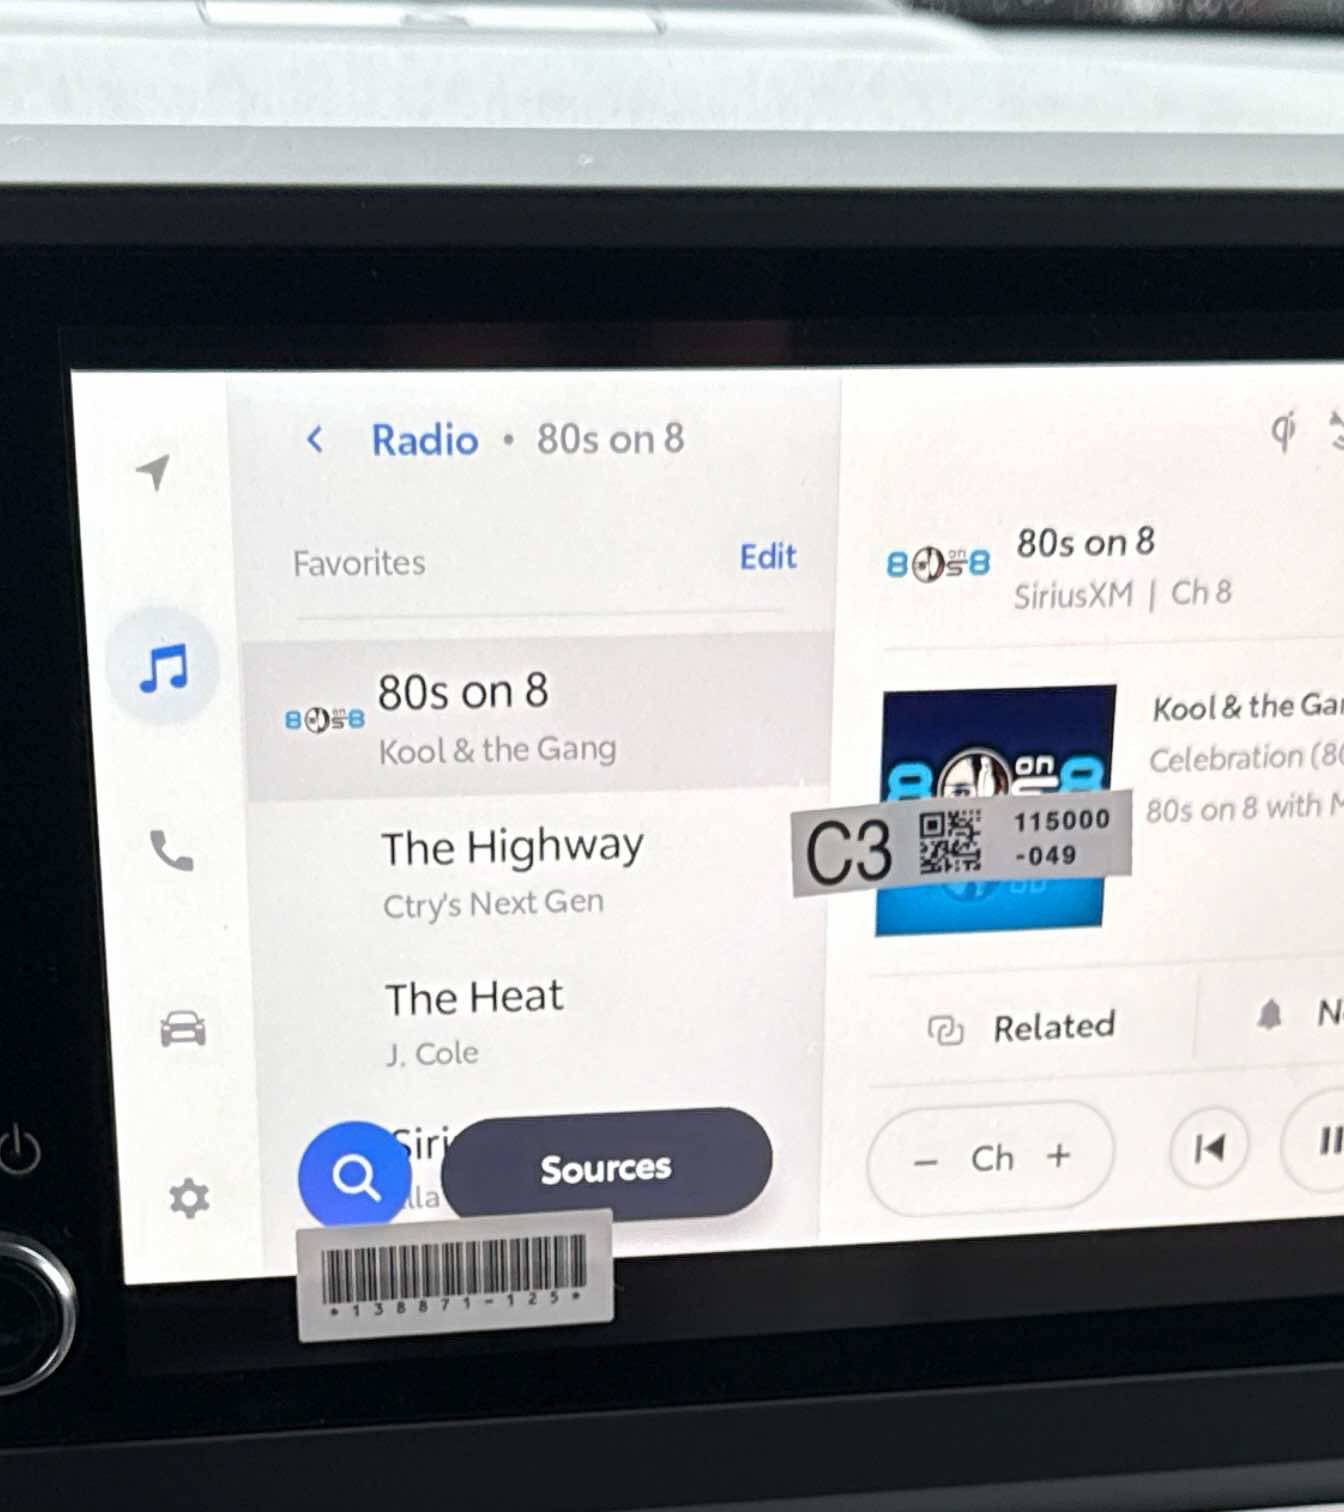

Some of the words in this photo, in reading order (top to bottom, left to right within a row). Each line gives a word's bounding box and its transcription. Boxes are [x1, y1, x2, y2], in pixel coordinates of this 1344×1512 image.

[373, 422, 479, 458] Radio
[537, 424, 599, 456] 80s
[609, 430, 654, 454] on
[665, 423, 685, 454] 8
[740, 543, 798, 572] Edit
[1017, 527, 1075, 559] 80s
[1084, 533, 1128, 557] on
[1136, 526, 1155, 556] 8
[293, 550, 426, 578] Favorites
[1014, 582, 1133, 611] SiriusXM
[1171, 579, 1209, 608] Ch
[1214, 579, 1232, 605] 8
[378, 674, 449, 711] 80s
[462, 681, 513, 708] on
[526, 672, 549, 707] 8
[1153, 695, 1215, 722] Kool
[1221, 695, 1242, 720] &
[1248, 693, 1295, 719] the
[379, 738, 447, 766] Kool
[453, 738, 476, 764] &
[482, 737, 531, 763] the
[537, 736, 617, 768] Gang
[1016, 755, 1055, 775] on
[1150, 745, 1304, 774] Celebration
[1015, 808, 1112, 832] 115000
[1147, 798, 1194, 825] 80s
[1201, 801, 1235, 822] on
[1242, 796, 1259, 822] 8
[1266, 790, 1323, 820] with
[382, 831, 455, 867] The
[468, 827, 646, 872] Highway
[806, 820, 894, 887] C3
[1016, 843, 1077, 866] -049
[384, 891, 462, 922] Ctry's
[470, 890, 539, 918] Next
[545, 888, 605, 915] Gen
[386, 981, 458, 1017] The
[470, 977, 564, 1014] Heat
[993, 1010, 1116, 1043] Related
[386, 1043, 407, 1068] J.
[416, 1040, 480, 1066] Cole
[541, 1153, 673, 1187] Sources
[971, 1145, 1015, 1173] Ch
